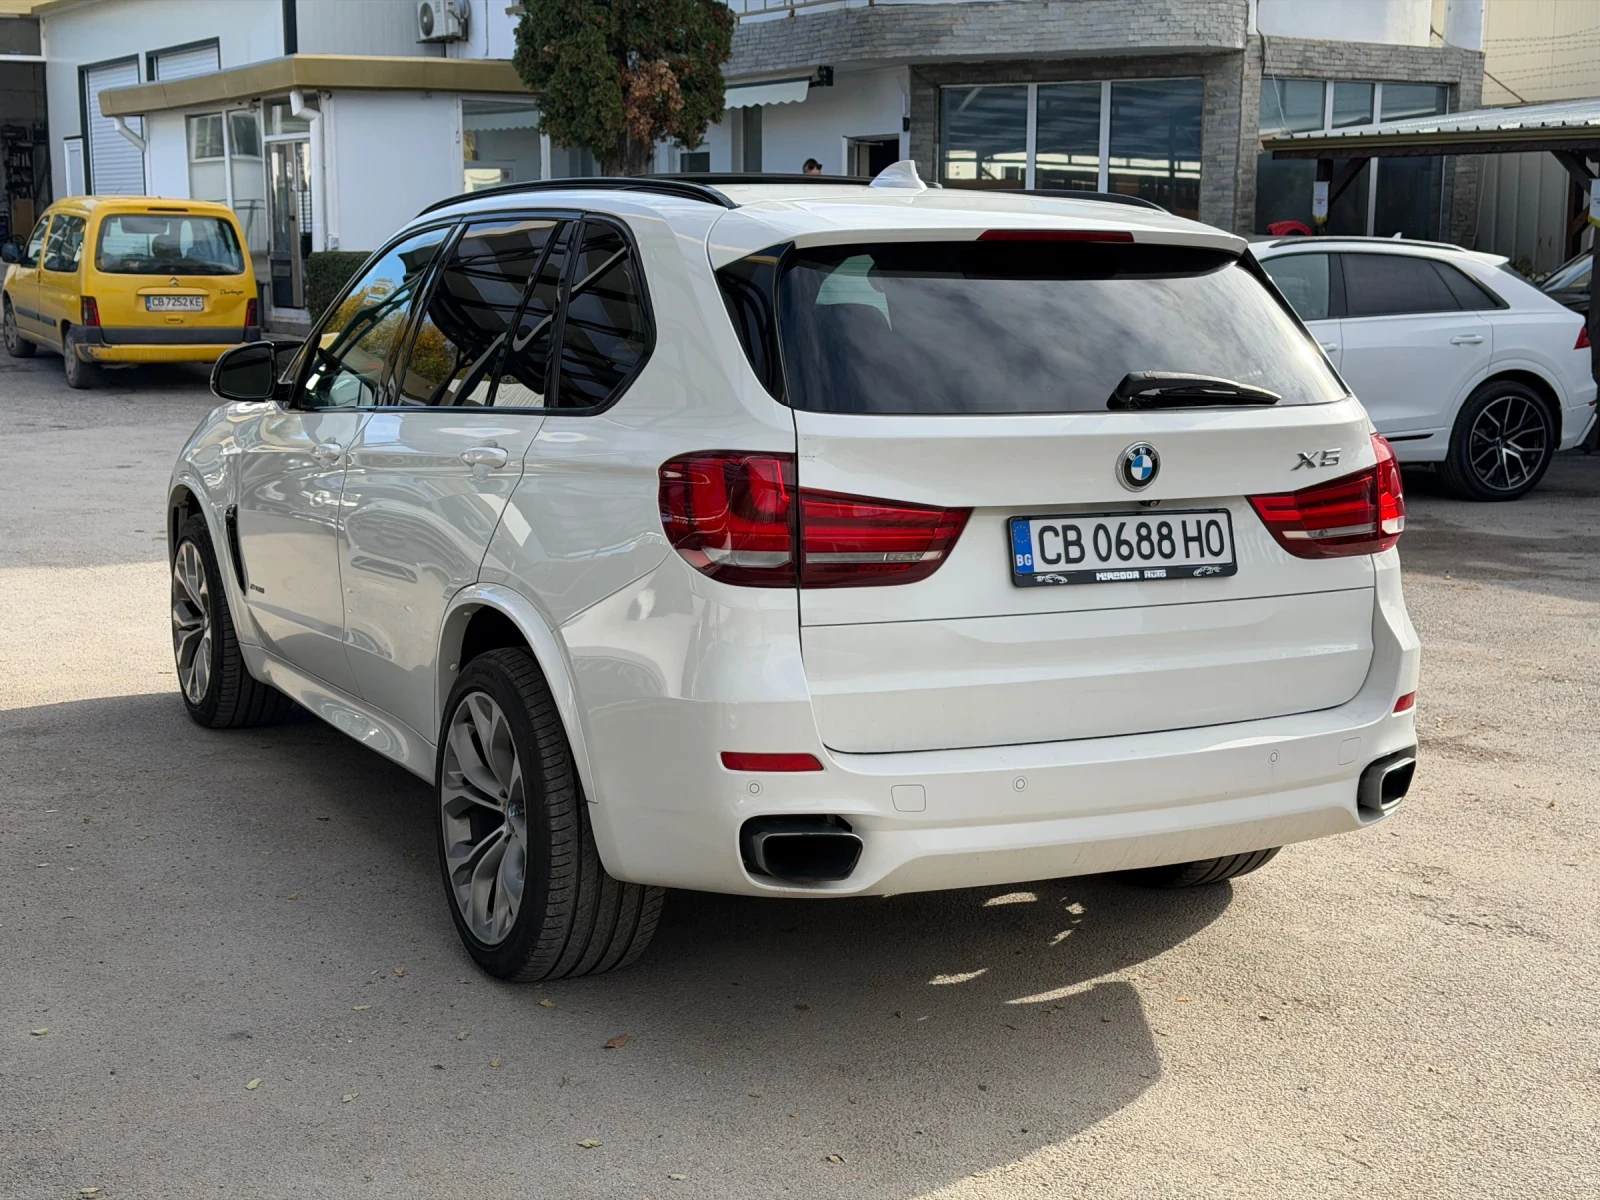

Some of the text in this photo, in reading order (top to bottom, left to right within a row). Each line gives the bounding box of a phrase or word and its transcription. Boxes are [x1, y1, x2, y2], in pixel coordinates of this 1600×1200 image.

[152, 297, 164, 307] CB
[166, 297, 188, 307] 7252
[190, 297, 201, 307] KE
[1128, 447, 1157, 461] BMW
[1290, 448, 1342, 471] X5
[1038, 525, 1086, 565] CB
[1092, 522, 1177, 562] 0688
[1016, 553, 1032, 567] BG
